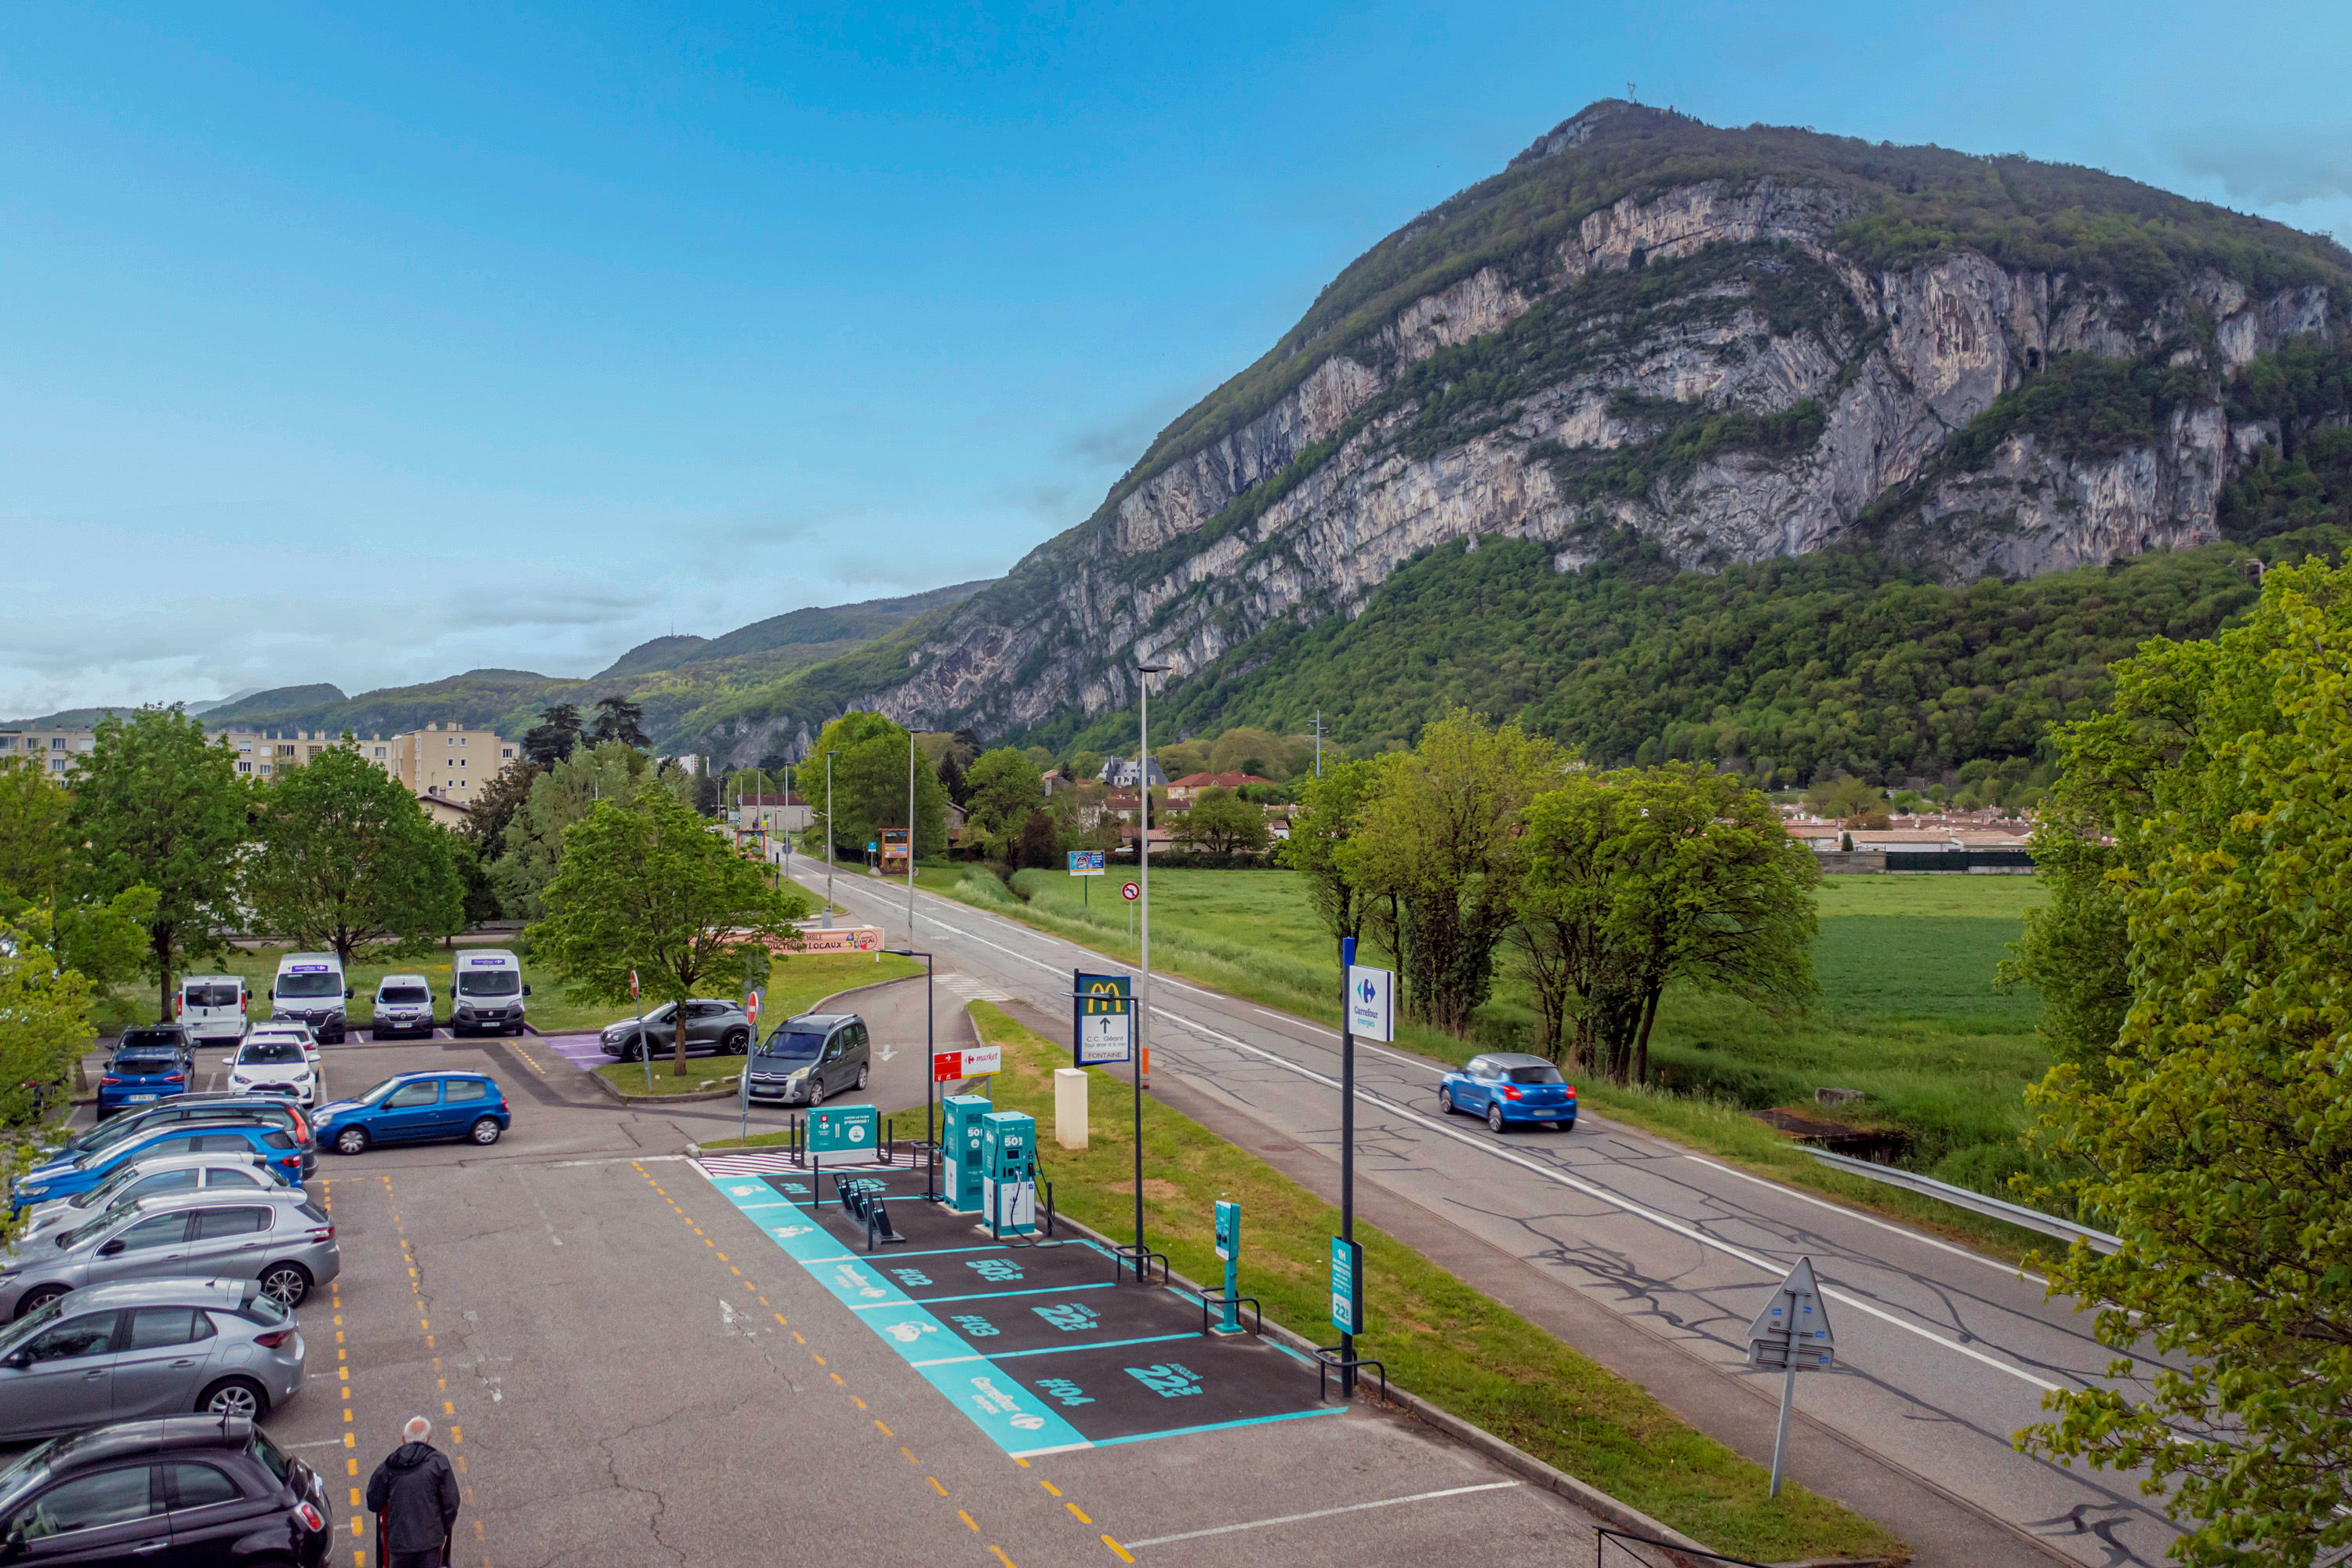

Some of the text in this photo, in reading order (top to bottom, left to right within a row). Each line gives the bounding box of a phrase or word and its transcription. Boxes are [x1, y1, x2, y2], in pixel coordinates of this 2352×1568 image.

[1354, 1005, 1378, 1018] Carrefour
[1357, 1015, 1375, 1029] énergies
[976, 1052, 998, 1062] market
[967, 1128, 980, 1137] 50
[1004, 1136, 1018, 1147] 50
[966, 1259, 1013, 1276] 50
[890, 1268, 933, 1287] #02
[1030, 1304, 1087, 1326] 22
[1335, 1302, 1346, 1319] 22
[950, 1314, 1000, 1337] #03
[1123, 1364, 1189, 1391] 22
[1035, 1377, 1097, 1406] #04
